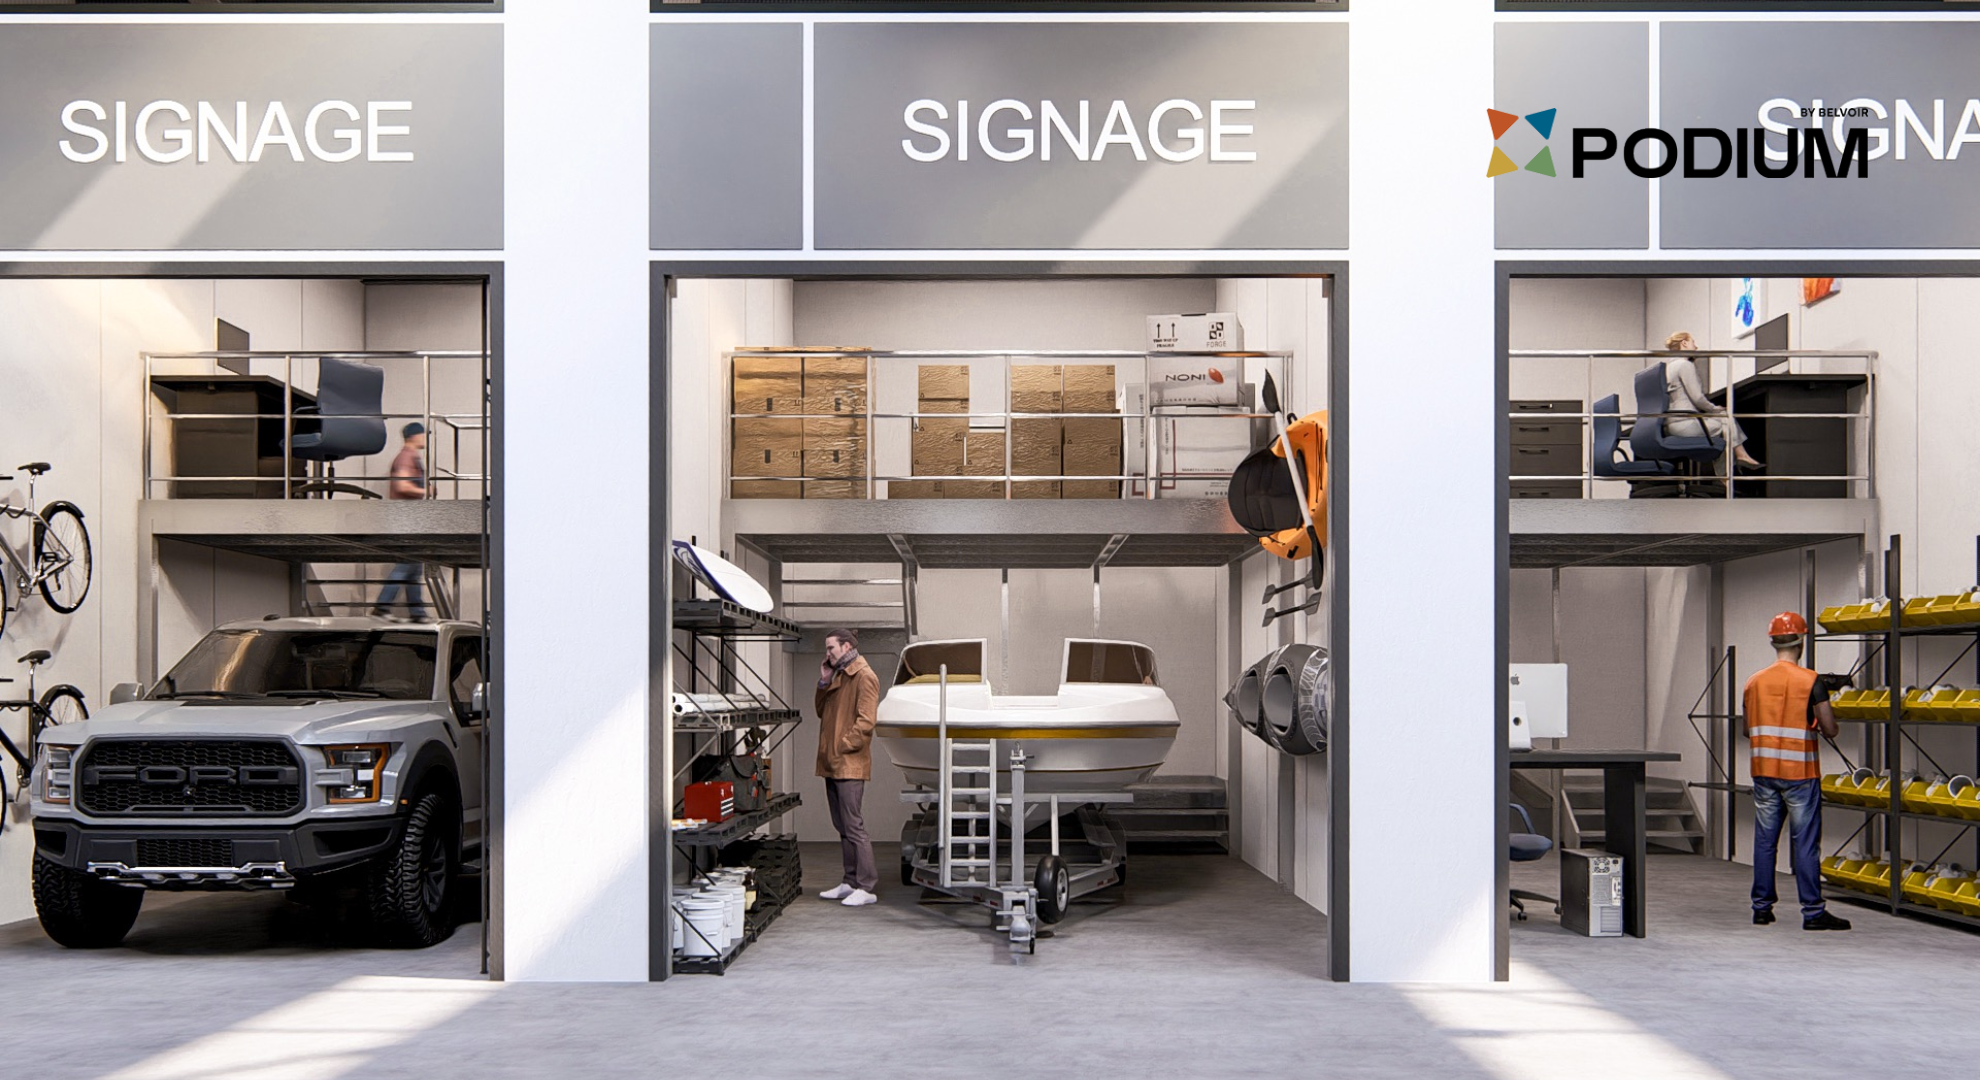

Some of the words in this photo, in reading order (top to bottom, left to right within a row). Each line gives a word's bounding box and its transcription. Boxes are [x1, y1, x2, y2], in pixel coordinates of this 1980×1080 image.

[59, 99, 415, 163] SIGNAGE
[901, 99, 1257, 162] SIGNAGE
[1165, 373, 1206, 382] NONI
